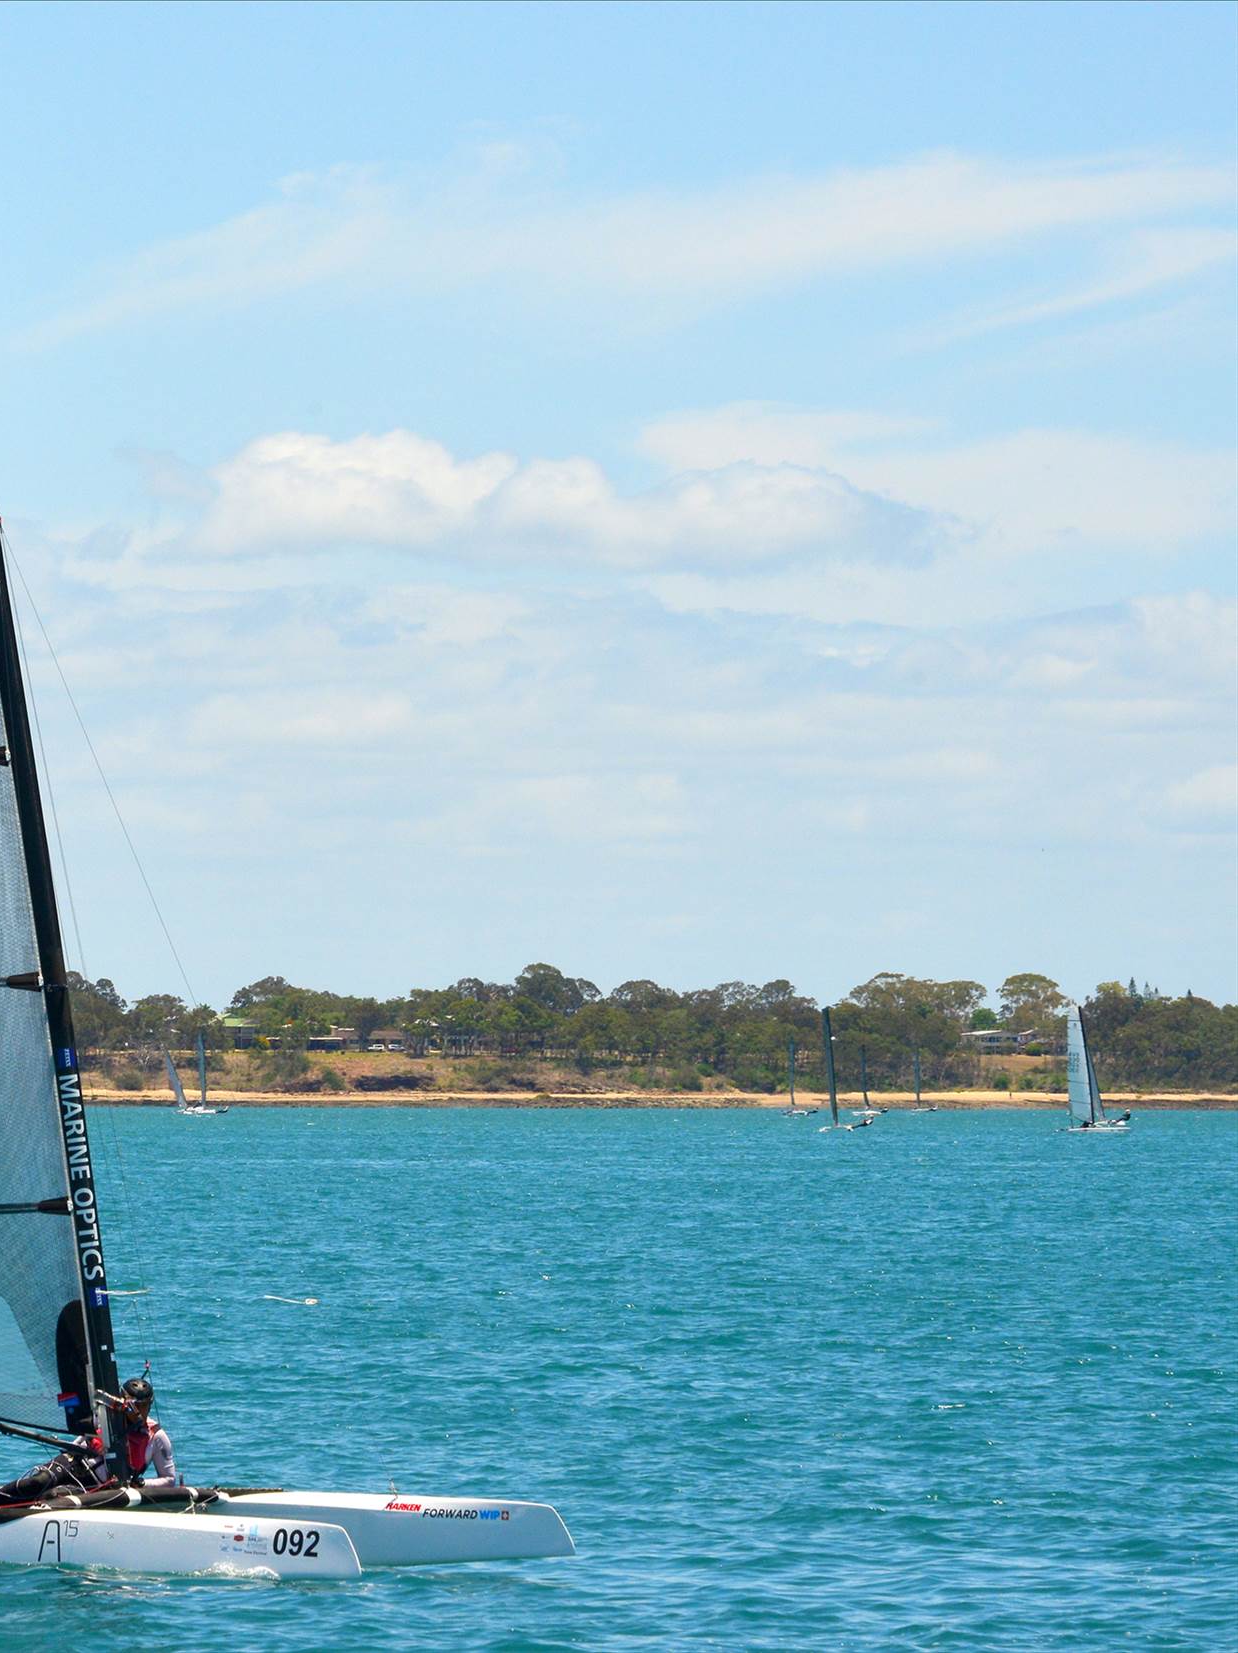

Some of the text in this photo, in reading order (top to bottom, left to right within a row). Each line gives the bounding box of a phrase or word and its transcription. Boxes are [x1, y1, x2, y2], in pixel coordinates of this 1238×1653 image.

[59, 1073, 104, 1281] MARINE OPTICS
[423, 1508, 501, 1520] FORWARD WIP
[273, 1528, 320, 1557] 092
